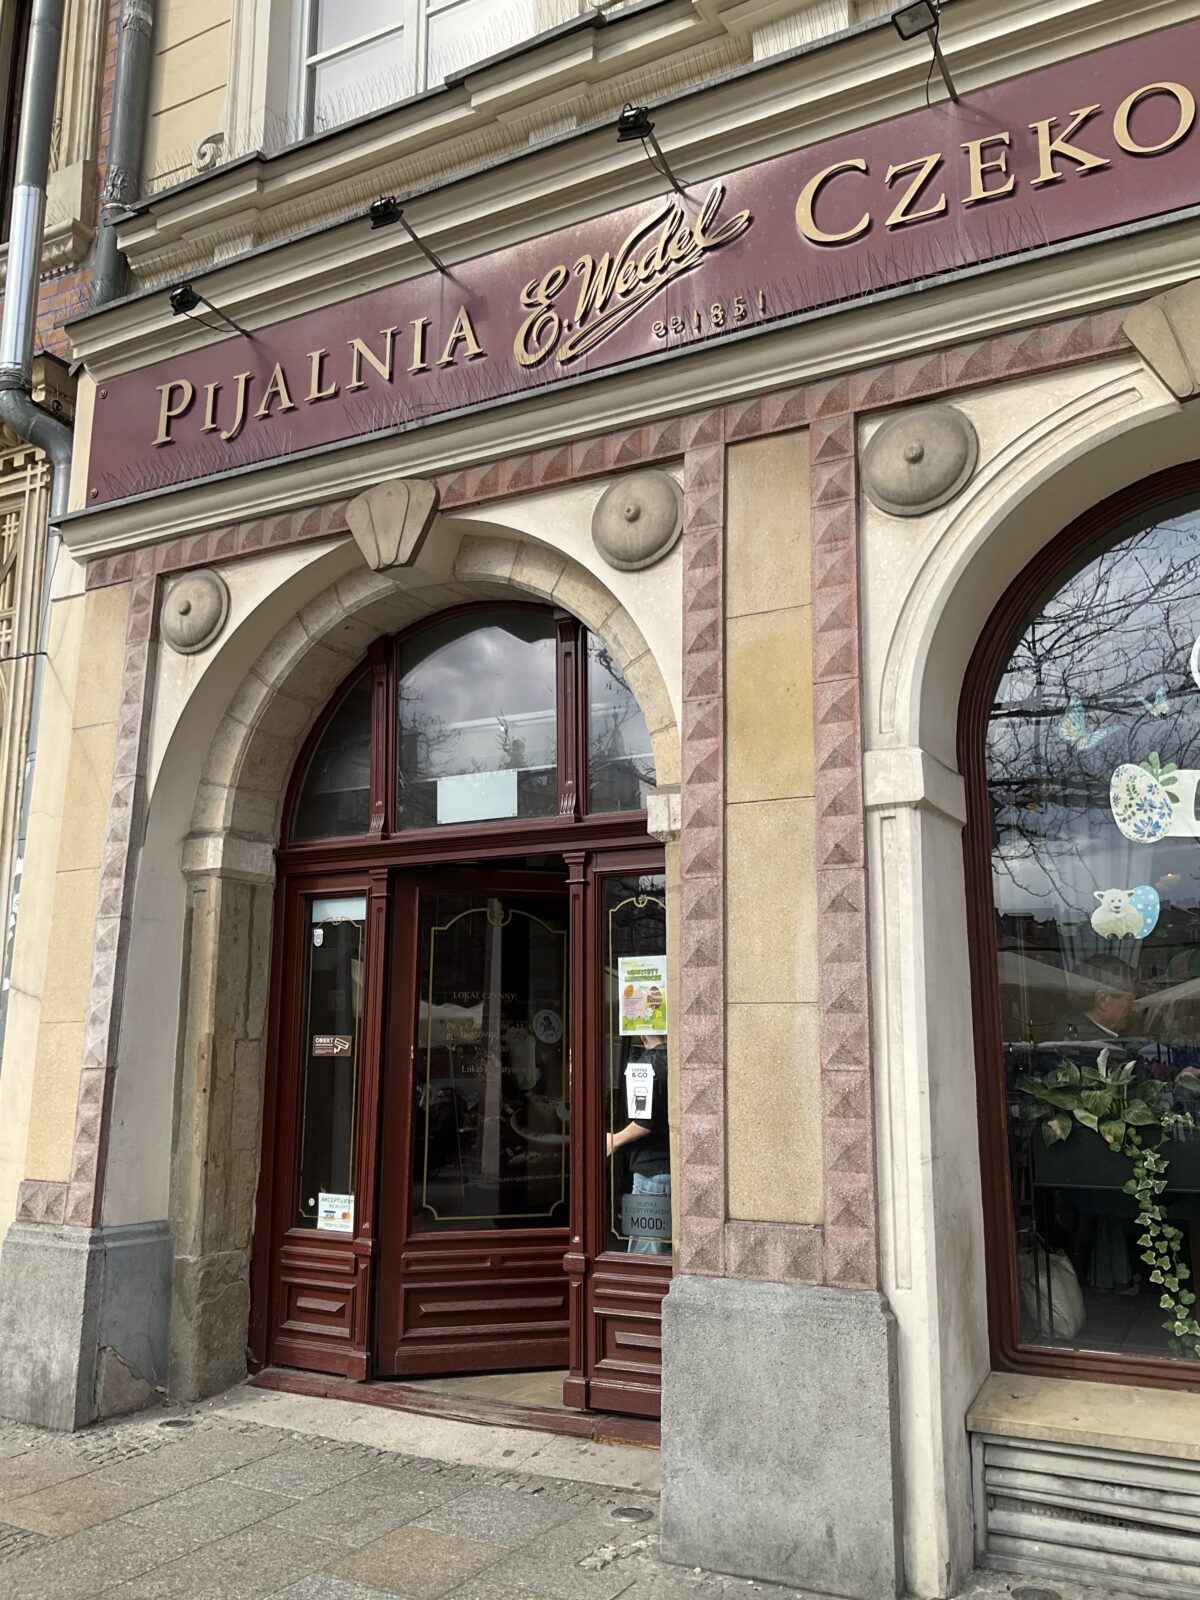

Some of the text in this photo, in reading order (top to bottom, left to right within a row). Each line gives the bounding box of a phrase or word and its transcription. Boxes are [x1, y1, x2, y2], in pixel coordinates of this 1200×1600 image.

[156, 309, 484, 445] PIJALNIA
[794, 81, 1196, 244] CZEKO
[693, 290, 765, 333] 1851
[453, 991, 480, 999] LOKAL
[630, 1216, 666, 1231] MOOD:
